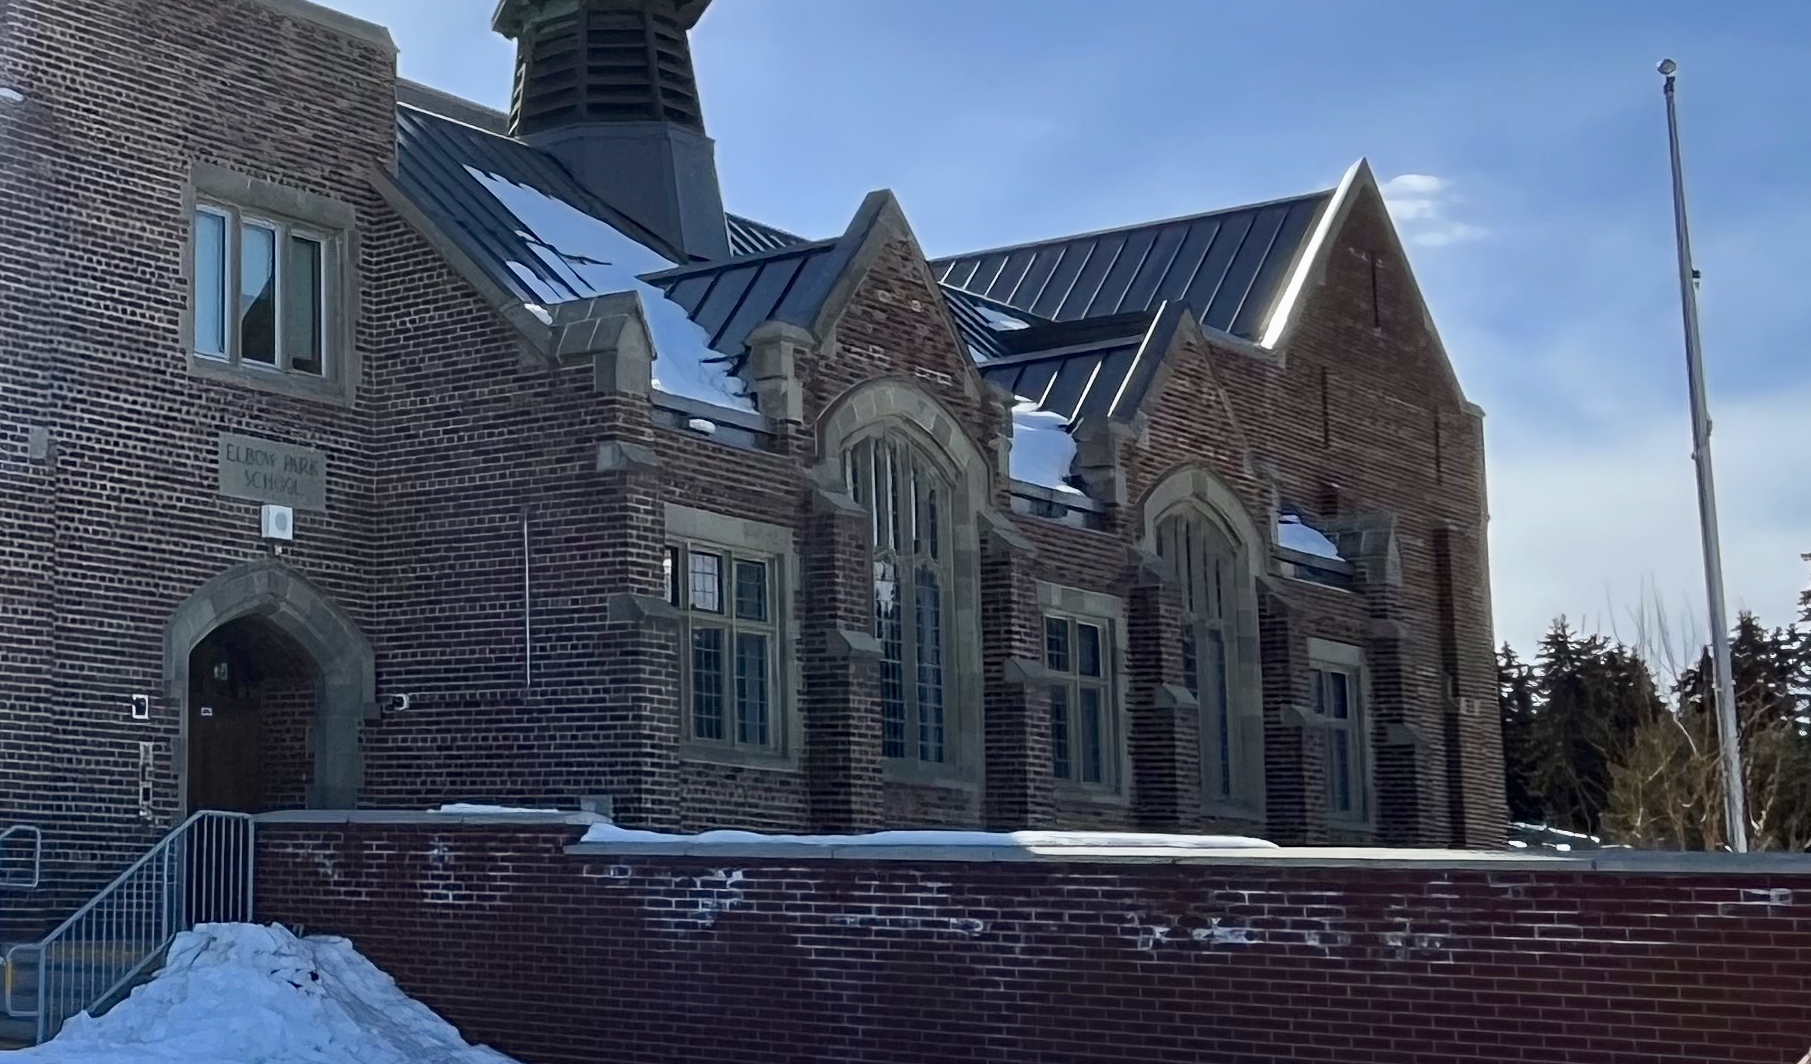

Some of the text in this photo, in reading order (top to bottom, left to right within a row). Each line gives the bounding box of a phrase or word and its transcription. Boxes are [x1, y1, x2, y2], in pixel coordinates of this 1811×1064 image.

[225, 442, 319, 476] ELBOW PARK
[244, 469, 304, 496] SCHOOL
